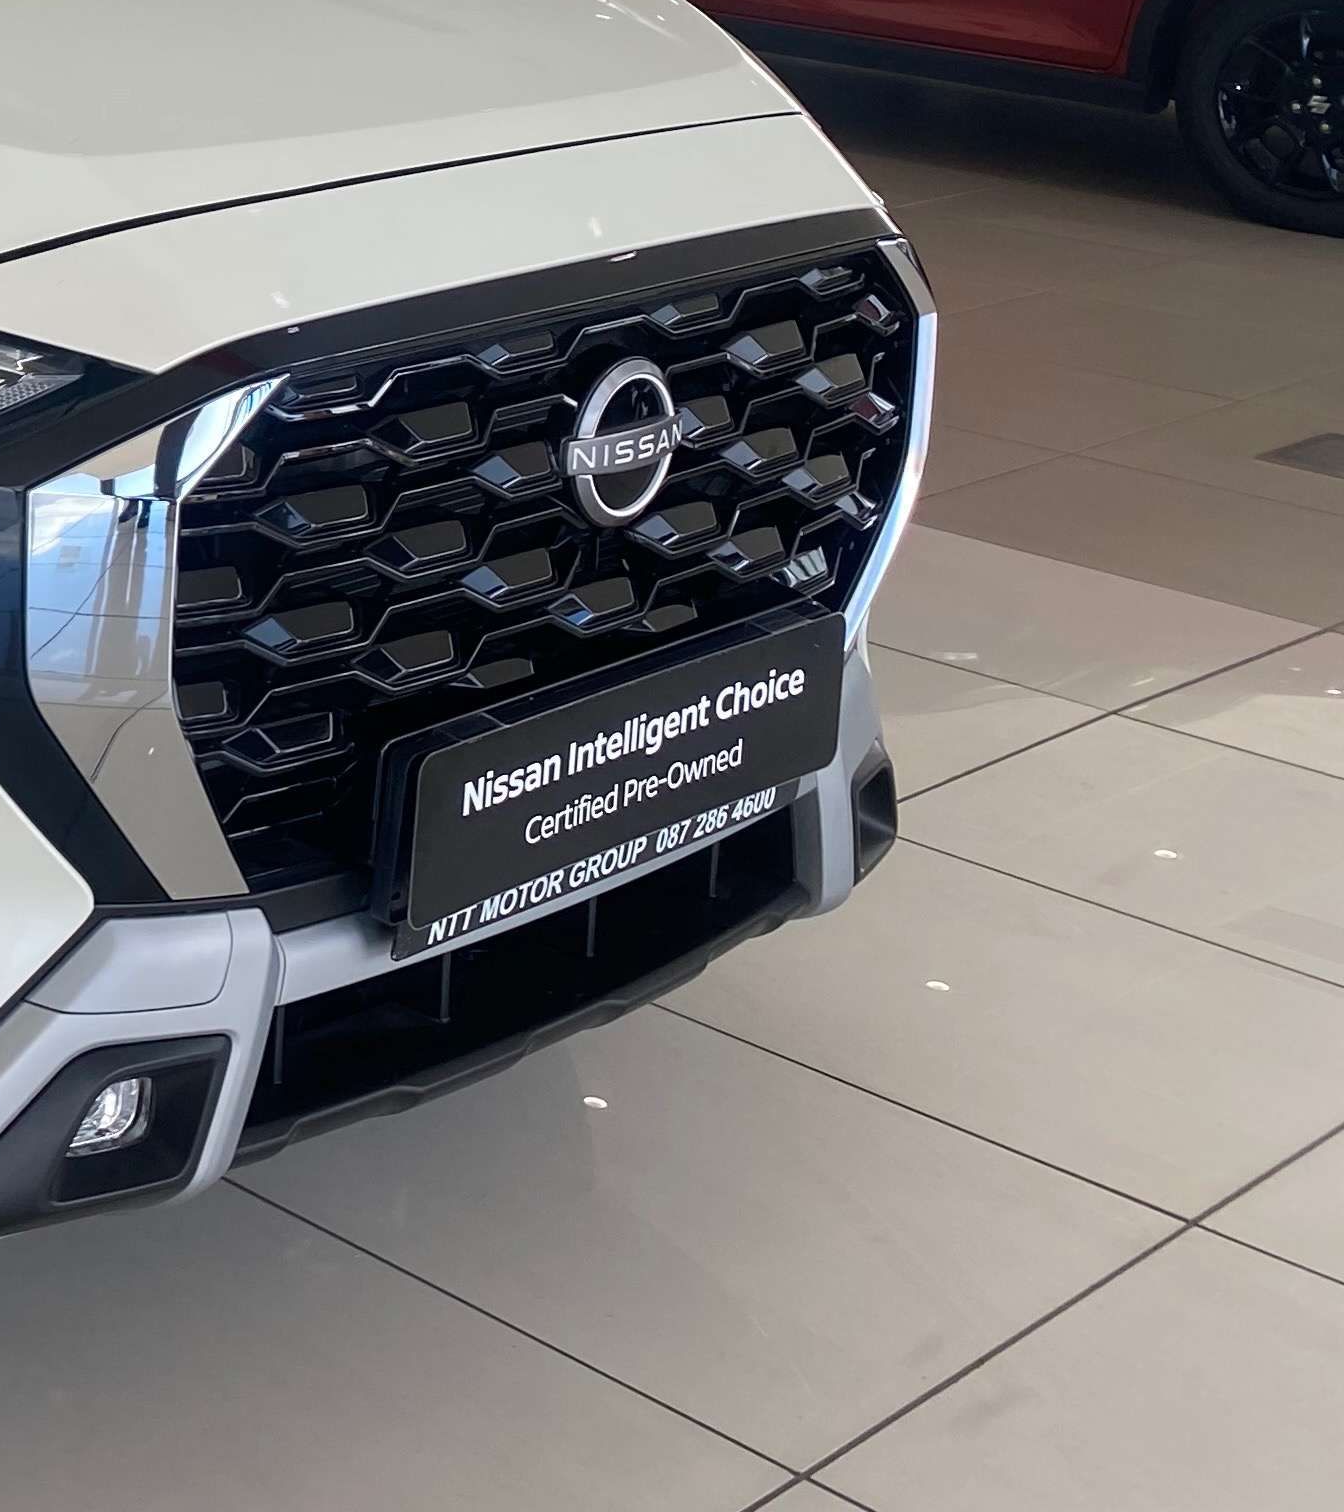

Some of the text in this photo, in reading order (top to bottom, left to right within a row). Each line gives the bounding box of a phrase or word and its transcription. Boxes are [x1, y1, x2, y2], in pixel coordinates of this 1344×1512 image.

[571, 419, 683, 471] NISSAN
[461, 668, 805, 817] Nissan Intelligent Choice
[524, 738, 743, 844] Certified Pre-Owned
[426, 785, 777, 945] NTT MOTOR GROUP 087 286 4600
